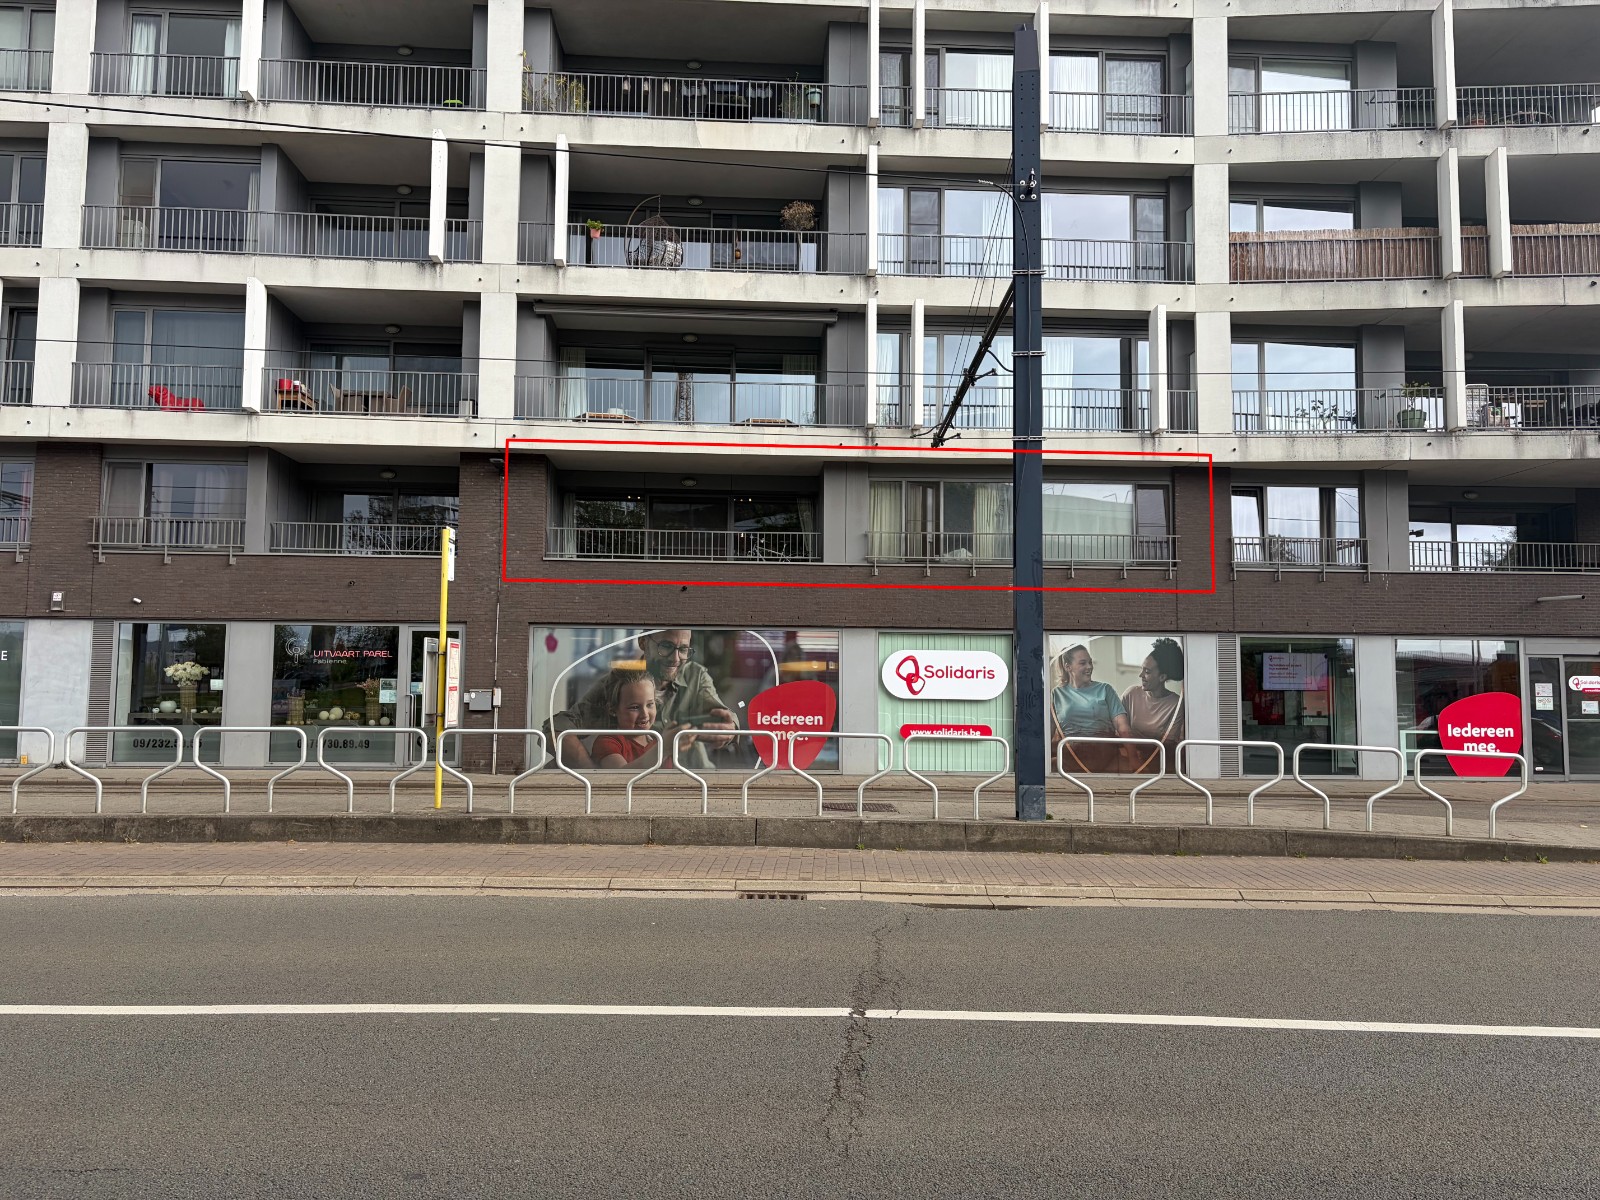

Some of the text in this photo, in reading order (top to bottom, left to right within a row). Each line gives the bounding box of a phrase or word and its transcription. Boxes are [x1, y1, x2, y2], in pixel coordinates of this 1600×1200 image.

[313, 650, 393, 658] UITVAART PAREL
[923, 665, 996, 680] Solidaris
[757, 710, 824, 726] Iedereen
[910, 727, 982, 737] www.solidaris.be
[1447, 722, 1515, 738] Iedereen
[1463, 742, 1501, 753] mee.
